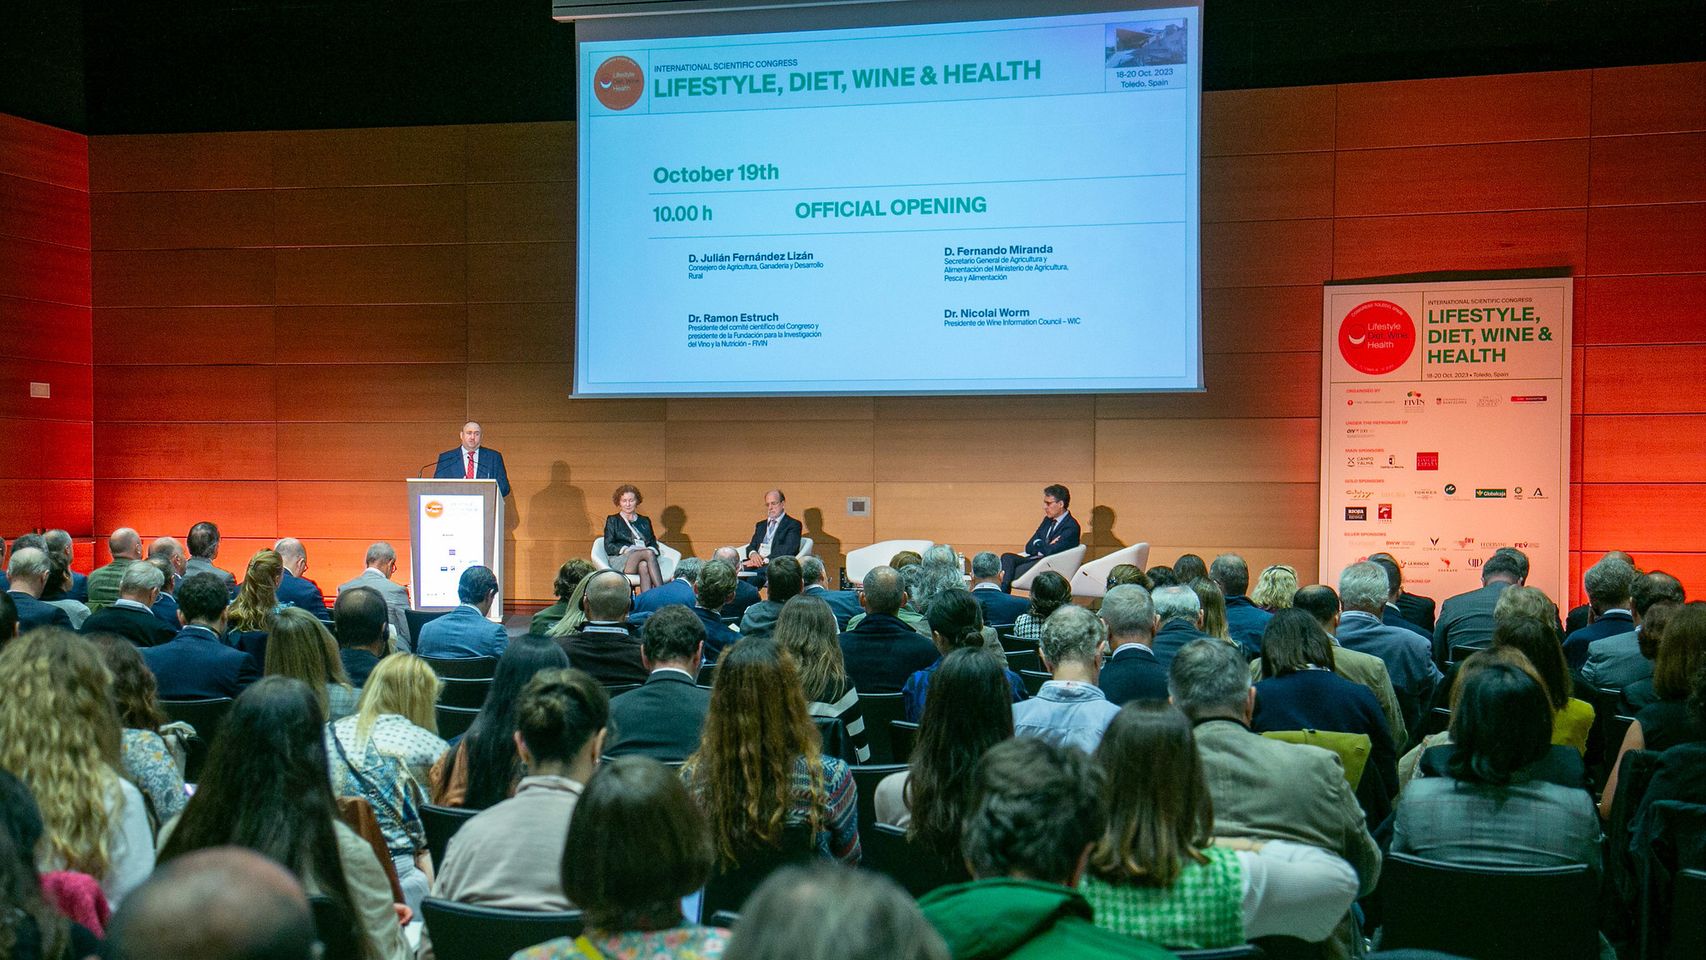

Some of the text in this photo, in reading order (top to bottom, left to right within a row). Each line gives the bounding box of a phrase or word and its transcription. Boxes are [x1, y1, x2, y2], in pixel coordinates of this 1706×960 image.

[654, 58, 798, 73] INTERNATIONAL SCIENTIFIC CONGRESS
[1116, 70, 1136, 78] 18-20
[1154, 68, 1174, 76] 2023
[654, 59, 1041, 98] LIFESTYLE, DIET, WINE & HEALTH
[1120, 80, 1168, 88] Toledo, Spain
[653, 163, 779, 184] October 19th
[795, 196, 987, 219] OFFICIAL OPENING
[653, 205, 712, 222] 10.00 h
[944, 245, 1053, 256] D. Fernando Miranda
[688, 251, 813, 263] D. Julián Fernández Lizán
[944, 257, 975, 265] Secretario
[976, 256, 1000, 264] General
[1010, 255, 1043, 264] Agricultura
[688, 264, 717, 272] Consejero
[726, 263, 758, 272] Agricultura,
[794, 261, 824, 269] Desarrollo
[944, 265, 983, 273] Alimentación
[994, 264, 1024, 272] Ministerio
[1034, 263, 1069, 272] Agricultura,
[968, 273, 1007, 281] Alimentación
[688, 312, 779, 323] Dr. Ramon Estruch
[944, 308, 1030, 318] Dr. Nicolai Worm
[1428, 306, 1541, 324] LIFESTYLE,
[719, 323, 728, 331] del
[728, 323, 748, 331] comité
[776, 322, 785, 330] del
[786, 322, 815, 331] Congreso
[944, 319, 976, 327] Presidente
[1002, 318, 1038, 326] Information
[1039, 317, 1062, 325] Council
[1067, 317, 1081, 325] WIC
[1367, 323, 1401, 332] Lifestyle
[688, 332, 718, 341] presidente
[734, 331, 763, 339] Fundación
[764, 332, 777, 340] para
[784, 331, 821, 339] Investigación
[1428, 326, 1553, 345] DIET, WINE &
[688, 340, 697, 348] del
[1367, 341, 1394, 349] Health
[1428, 348, 1506, 364] HEALTH
